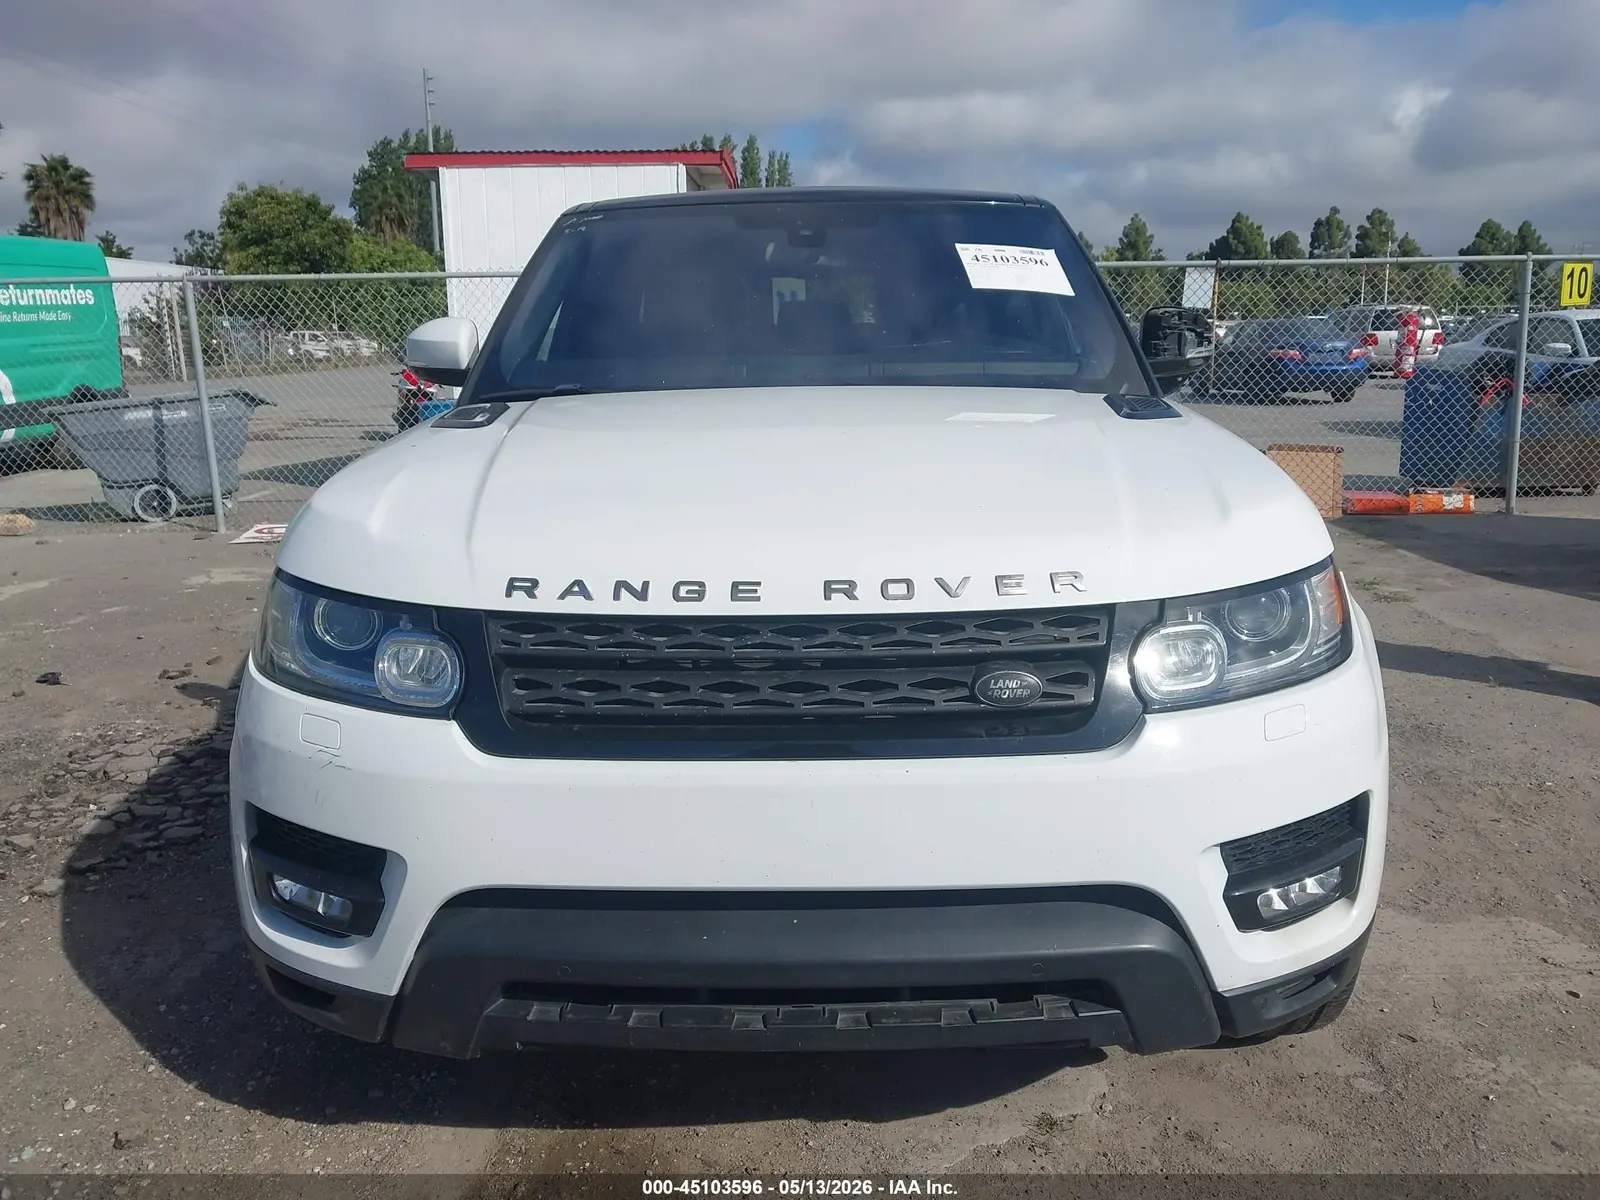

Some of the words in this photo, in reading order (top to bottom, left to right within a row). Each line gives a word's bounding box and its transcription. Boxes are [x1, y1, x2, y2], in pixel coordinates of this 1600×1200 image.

[971, 254, 1049, 267] 45103596
[1566, 266, 1588, 299] 10
[12, 311, 38, 322] Returns
[39, 310, 57, 321] Made
[58, 310, 71, 322] Easy
[504, 576, 762, 603] RANGE
[823, 570, 1088, 601] ROVER
[989, 679, 1021, 689] LAND
[992, 688, 1031, 699] ROVER
